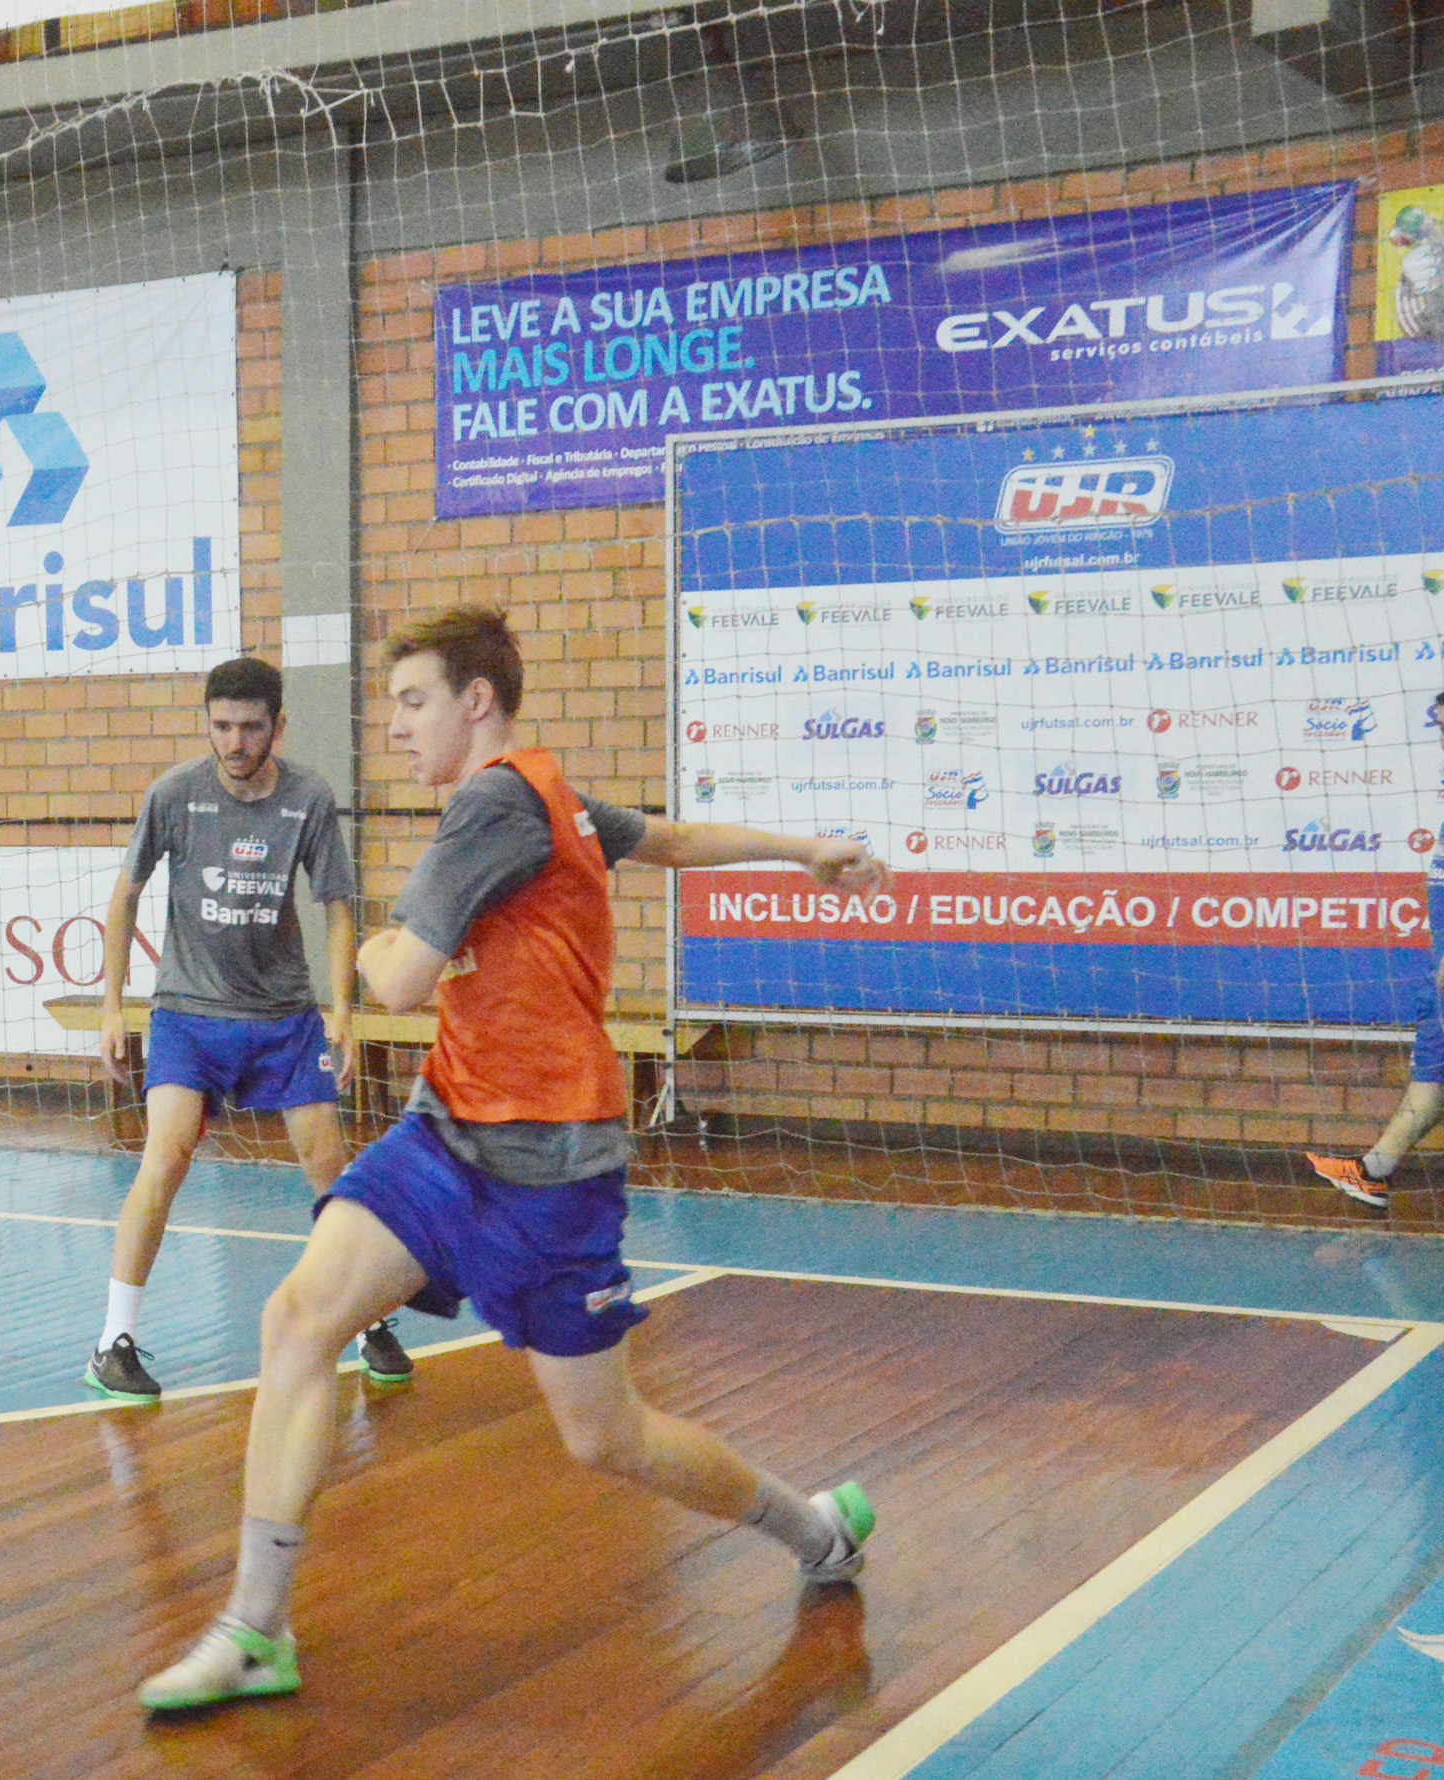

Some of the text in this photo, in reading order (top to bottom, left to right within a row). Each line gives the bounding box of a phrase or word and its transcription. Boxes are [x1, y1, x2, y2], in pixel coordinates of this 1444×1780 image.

[451, 263, 893, 345] LEVE A SUA EMPRESA
[936, 282, 1264, 353] EXATUS
[1049, 326, 1264, 362] serviços contábeis
[451, 325, 757, 396] MAIS LONGE.
[451, 370, 873, 442] FALE COM A EXATUS.
[452, 454, 520, 472] Contabilidade
[526, 453, 554, 466] Fiscal
[452, 473, 505, 488] Certificado
[507, 471, 539, 485] Digital
[545, 467, 585, 483] Agência
[1010, 470, 1157, 521] UJR
[712, 583, 1398, 628] FEEVALE FEEVALE FEEVALE FEEVALE FEEVALE FEEVALE
[704, 643, 1400, 685] Banrisul Banrisul Banrisul Banrisul Banrisul Banrisul
[712, 723, 780, 738] RENNER
[1021, 715, 1135, 732] ujrfutsal.com.br
[1178, 711, 1259, 729] RENNER
[791, 777, 896, 793] ujrfutsal.com.br
[1309, 769, 1394, 786] RENNER
[934, 835, 1007, 850] RENNER
[1141, 834, 1261, 850] ujrfutsal.com.br
[931, 889, 1156, 934] EDUCAÇÃO
